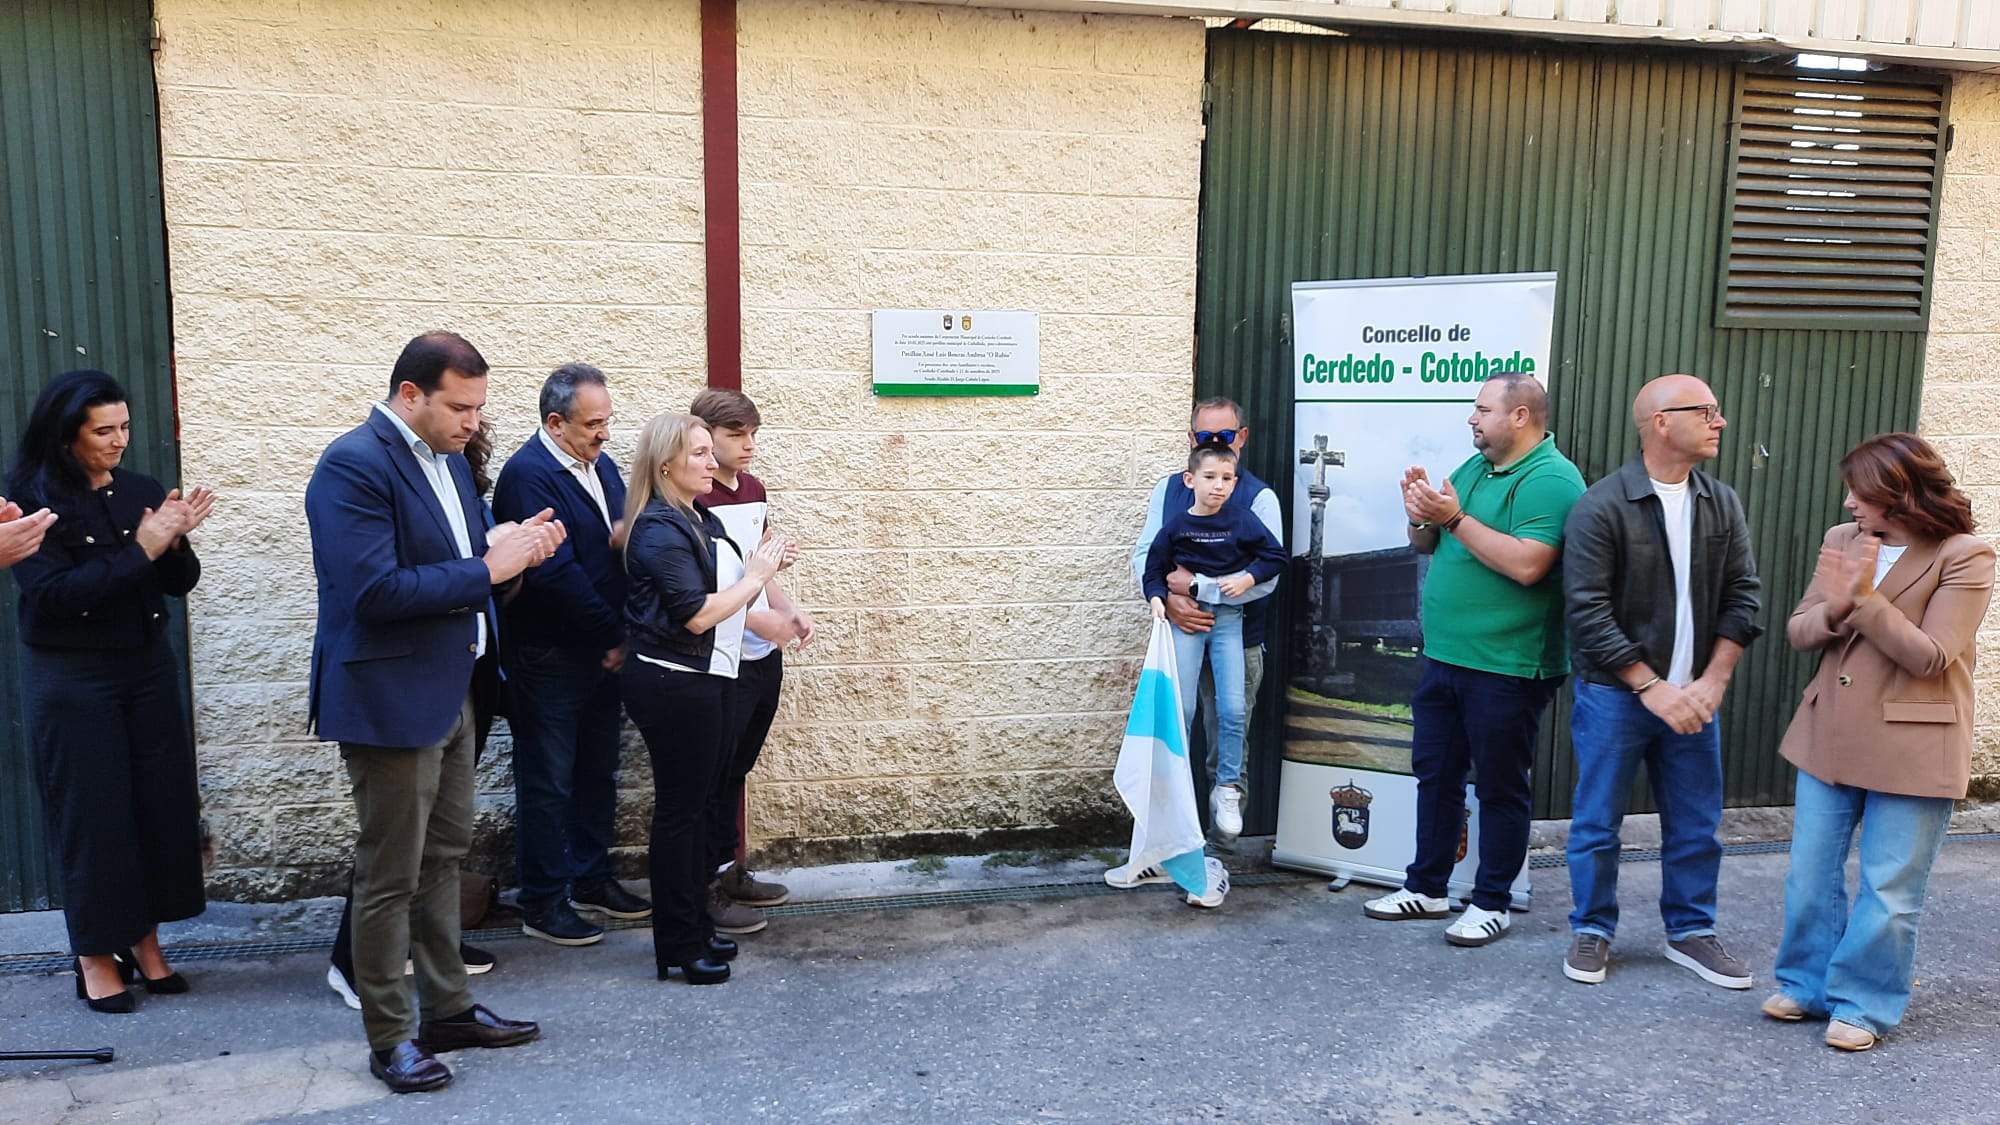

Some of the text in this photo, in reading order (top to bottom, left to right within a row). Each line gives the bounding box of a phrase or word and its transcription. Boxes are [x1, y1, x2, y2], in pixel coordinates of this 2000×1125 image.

[1362, 324, 1471, 343] Concello de
[1303, 351, 1536, 383] Cerdedo - Cotobade
